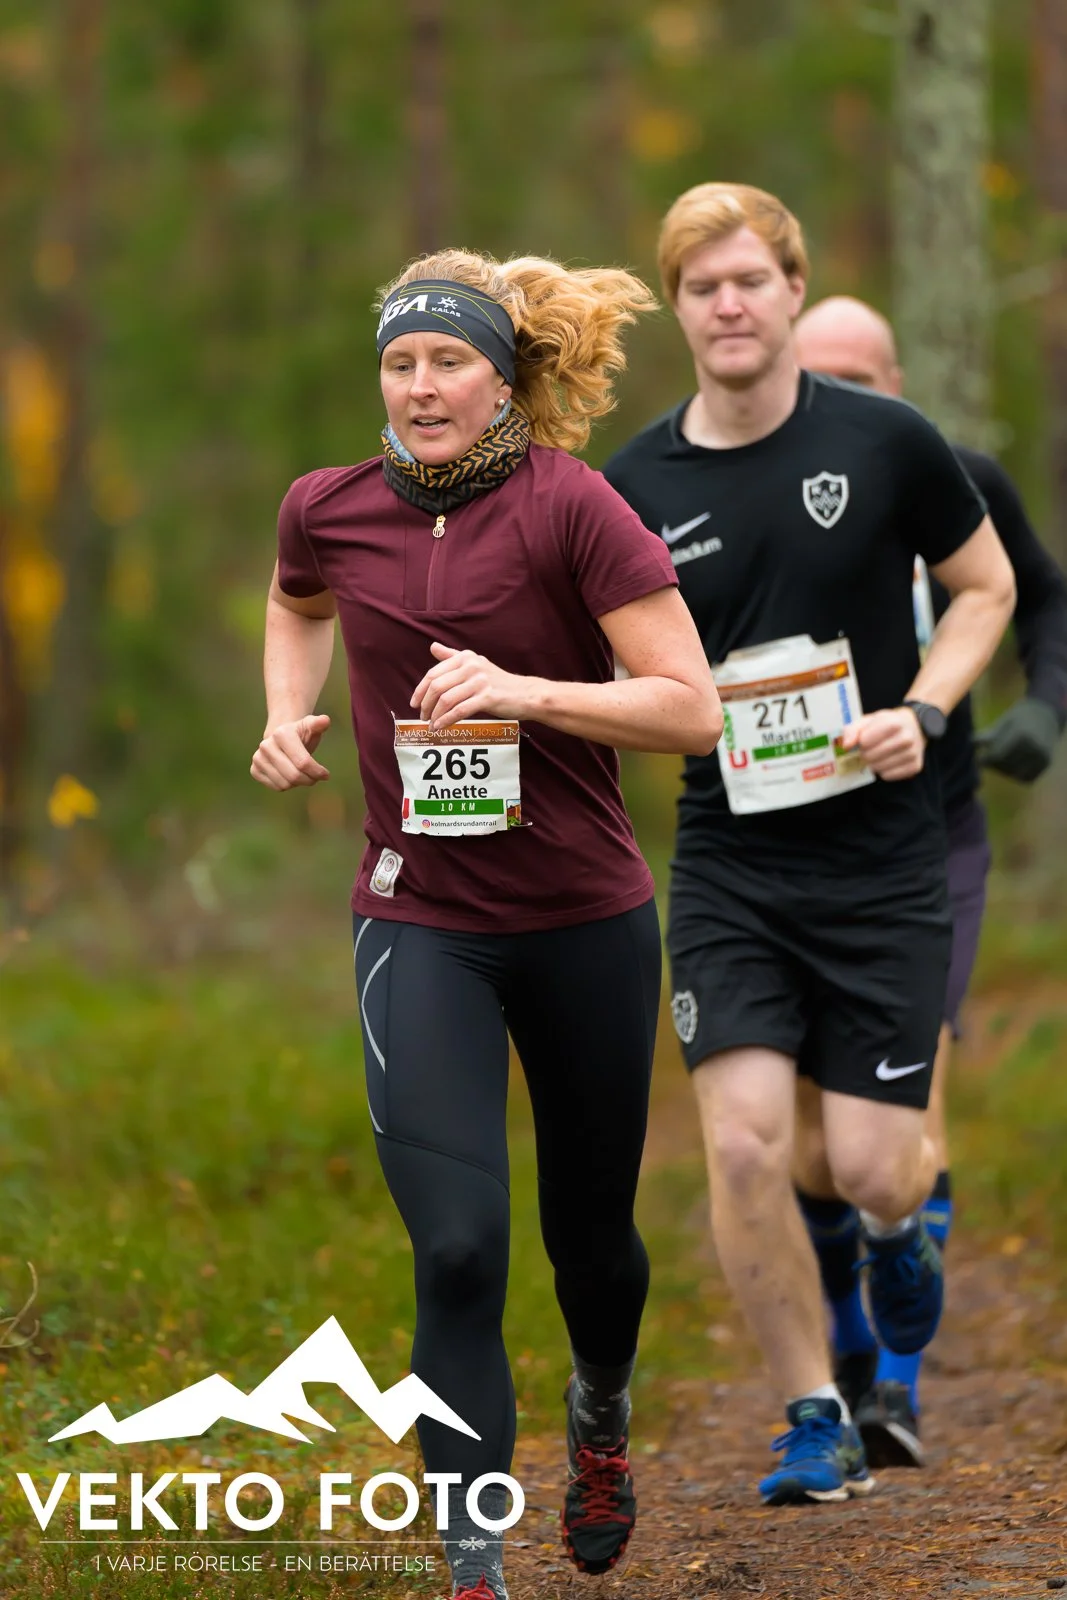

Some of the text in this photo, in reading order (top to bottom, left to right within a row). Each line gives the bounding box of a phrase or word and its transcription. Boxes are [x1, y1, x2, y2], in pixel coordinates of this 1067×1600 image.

[431, 306, 461, 318] KAILAS
[752, 694, 809, 729] 271
[761, 726, 816, 747] Martin
[421, 748, 491, 781] 265
[427, 784, 488, 800] Anette
[440, 802, 476, 812] 10 KM
